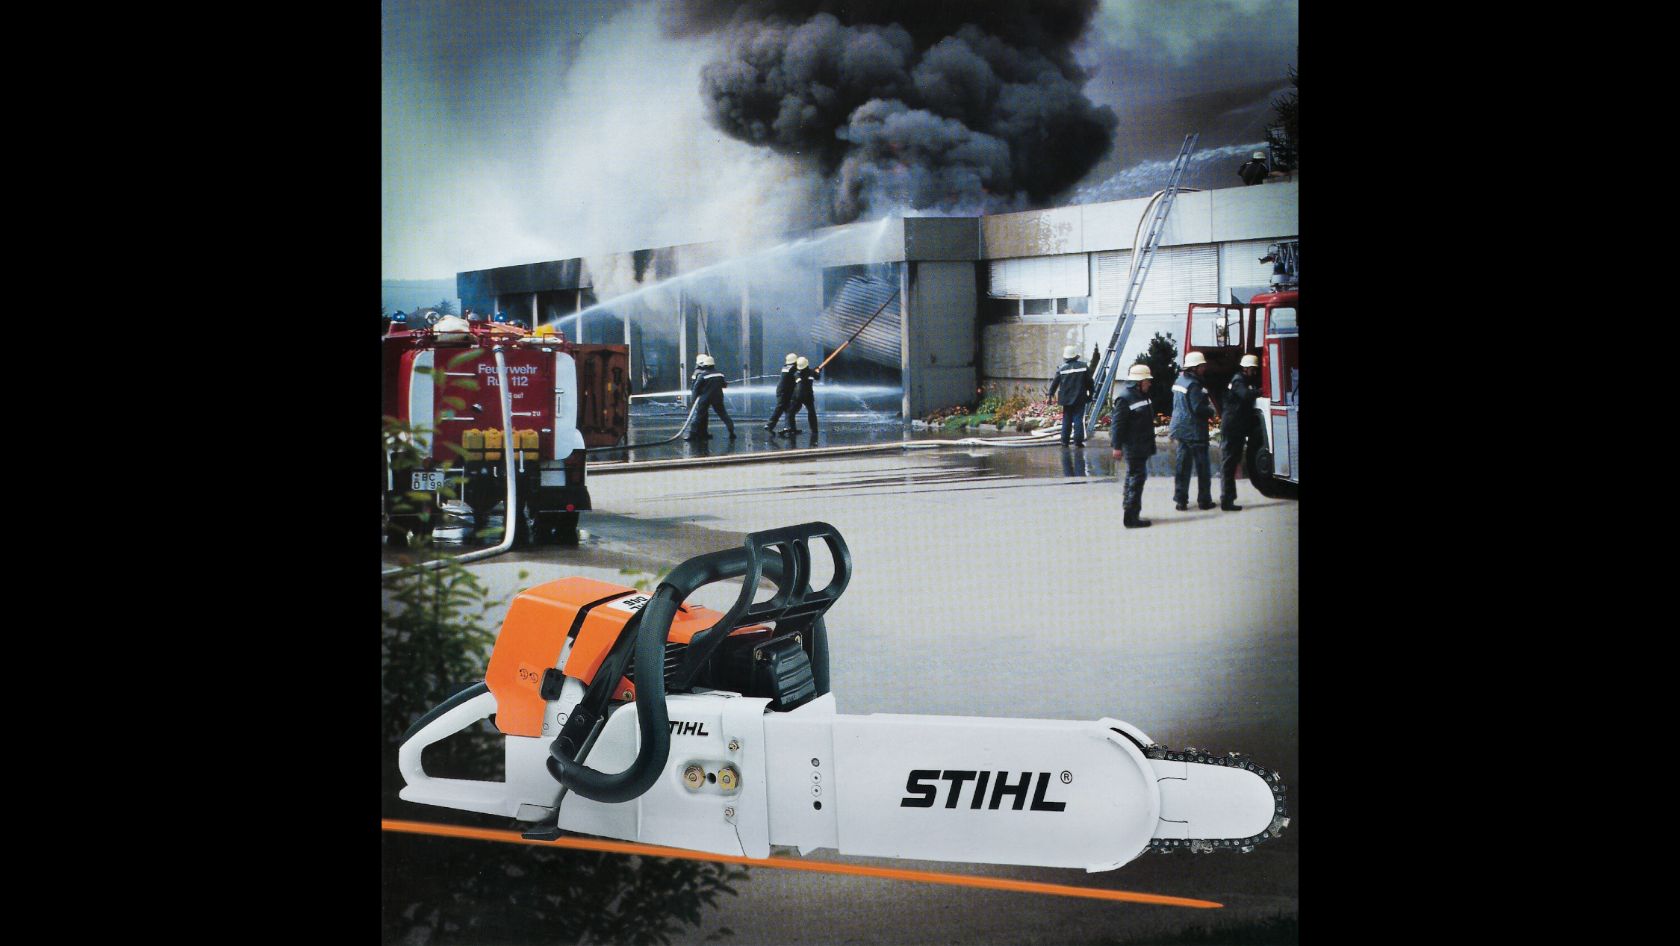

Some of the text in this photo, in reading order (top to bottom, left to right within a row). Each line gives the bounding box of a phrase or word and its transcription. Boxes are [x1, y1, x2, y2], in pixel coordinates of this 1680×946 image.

[478, 363, 538, 374] Feurwehr
[487, 376, 528, 386] Ru 112
[669, 720, 709, 736] TIHL
